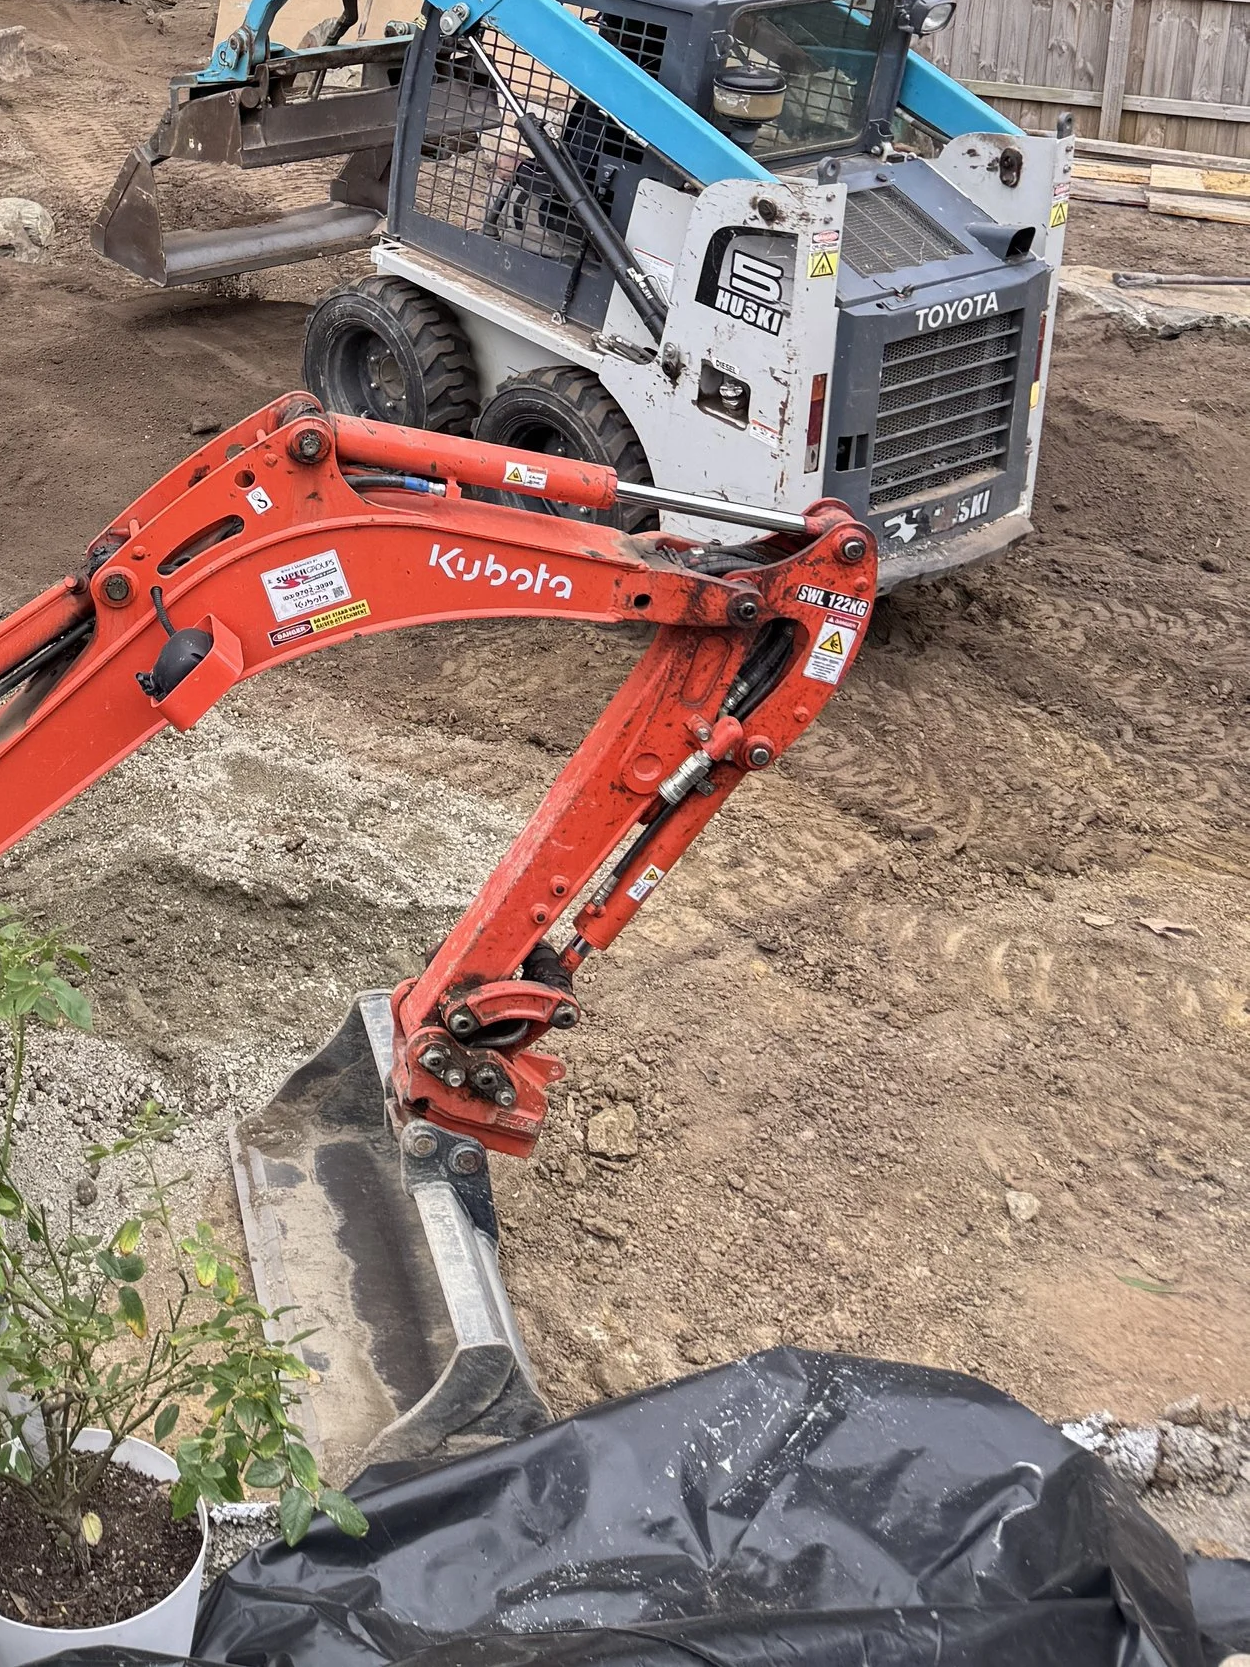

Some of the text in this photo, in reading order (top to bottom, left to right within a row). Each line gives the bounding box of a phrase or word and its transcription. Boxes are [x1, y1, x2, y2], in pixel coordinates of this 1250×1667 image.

[714, 288, 783, 334] HUSKI
[915, 291, 999, 332] TOYOTA
[715, 359, 737, 375] DIESEL
[428, 543, 574, 600] Kubota
[294, 594, 329, 609] Kubota
[798, 586, 868, 617] SWL 122KG
[277, 626, 306, 639] DANGER
